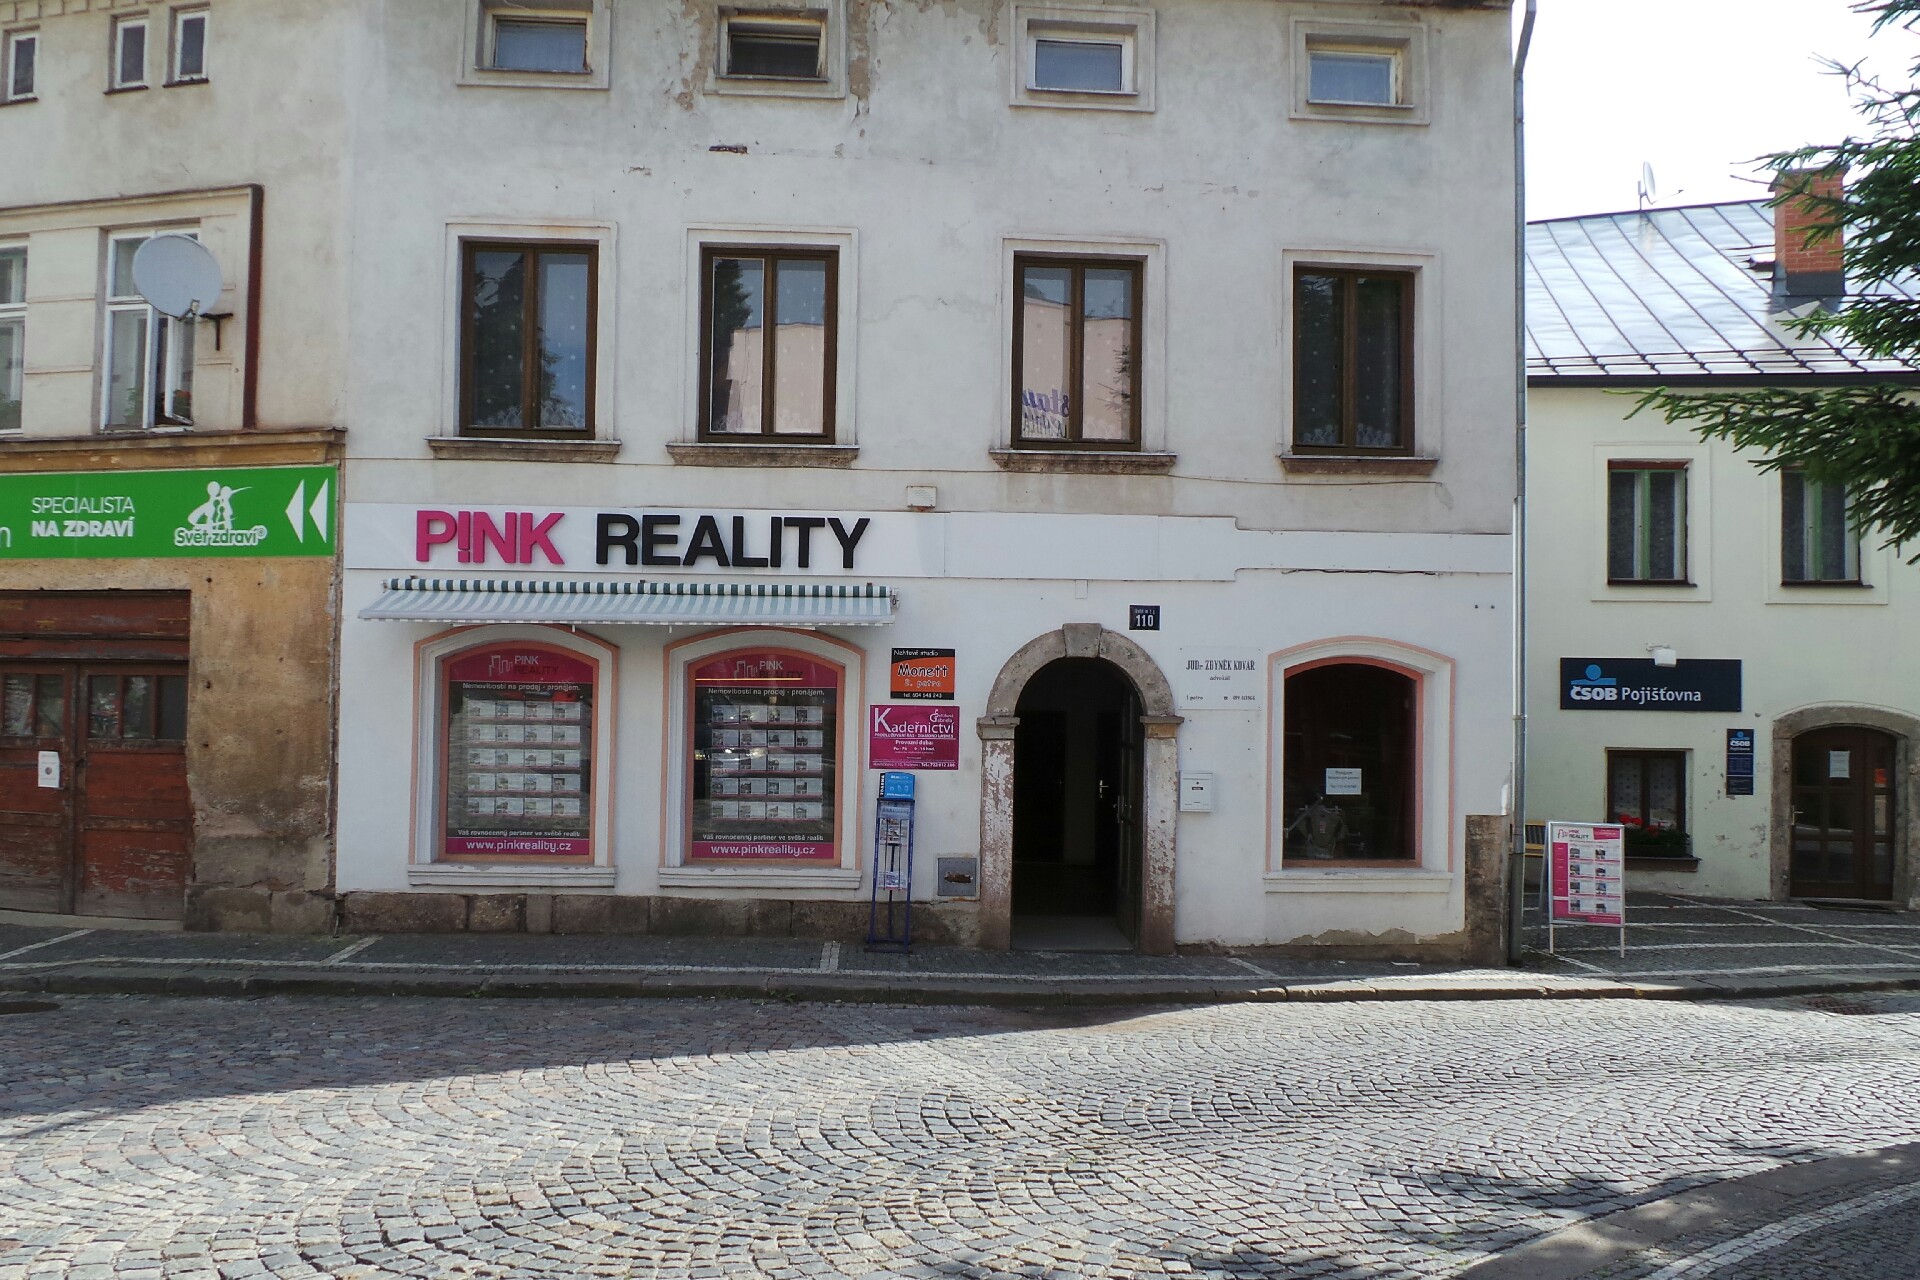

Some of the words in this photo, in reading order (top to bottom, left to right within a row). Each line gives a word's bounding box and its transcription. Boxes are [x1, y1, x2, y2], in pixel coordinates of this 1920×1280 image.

[32, 496, 135, 514] SPECIALISTA
[32, 520, 60, 537] NA
[63, 516, 135, 537] ZDRAVÍ
[176, 528, 209, 544] Svět
[596, 513, 870, 568] REALITY
[1135, 614, 1154, 627] 110
[514, 655, 539, 665] PINK
[759, 660, 783, 670] PINK
[897, 662, 949, 678] Monett
[462, 682, 506, 690] Nemovitosti
[518, 682, 541, 692] prodej
[916, 680, 942, 688] patro
[708, 688, 752, 696] Nemovitosti
[763, 688, 786, 698] prodej
[1570, 685, 1618, 701] ČSOB
[1621, 686, 1702, 705] Pojišťovna
[874, 707, 954, 734] Kadeřnictví
[466, 840, 572, 853] www.pinkreality.cz
[711, 844, 816, 857] www.pinkreality.cz
